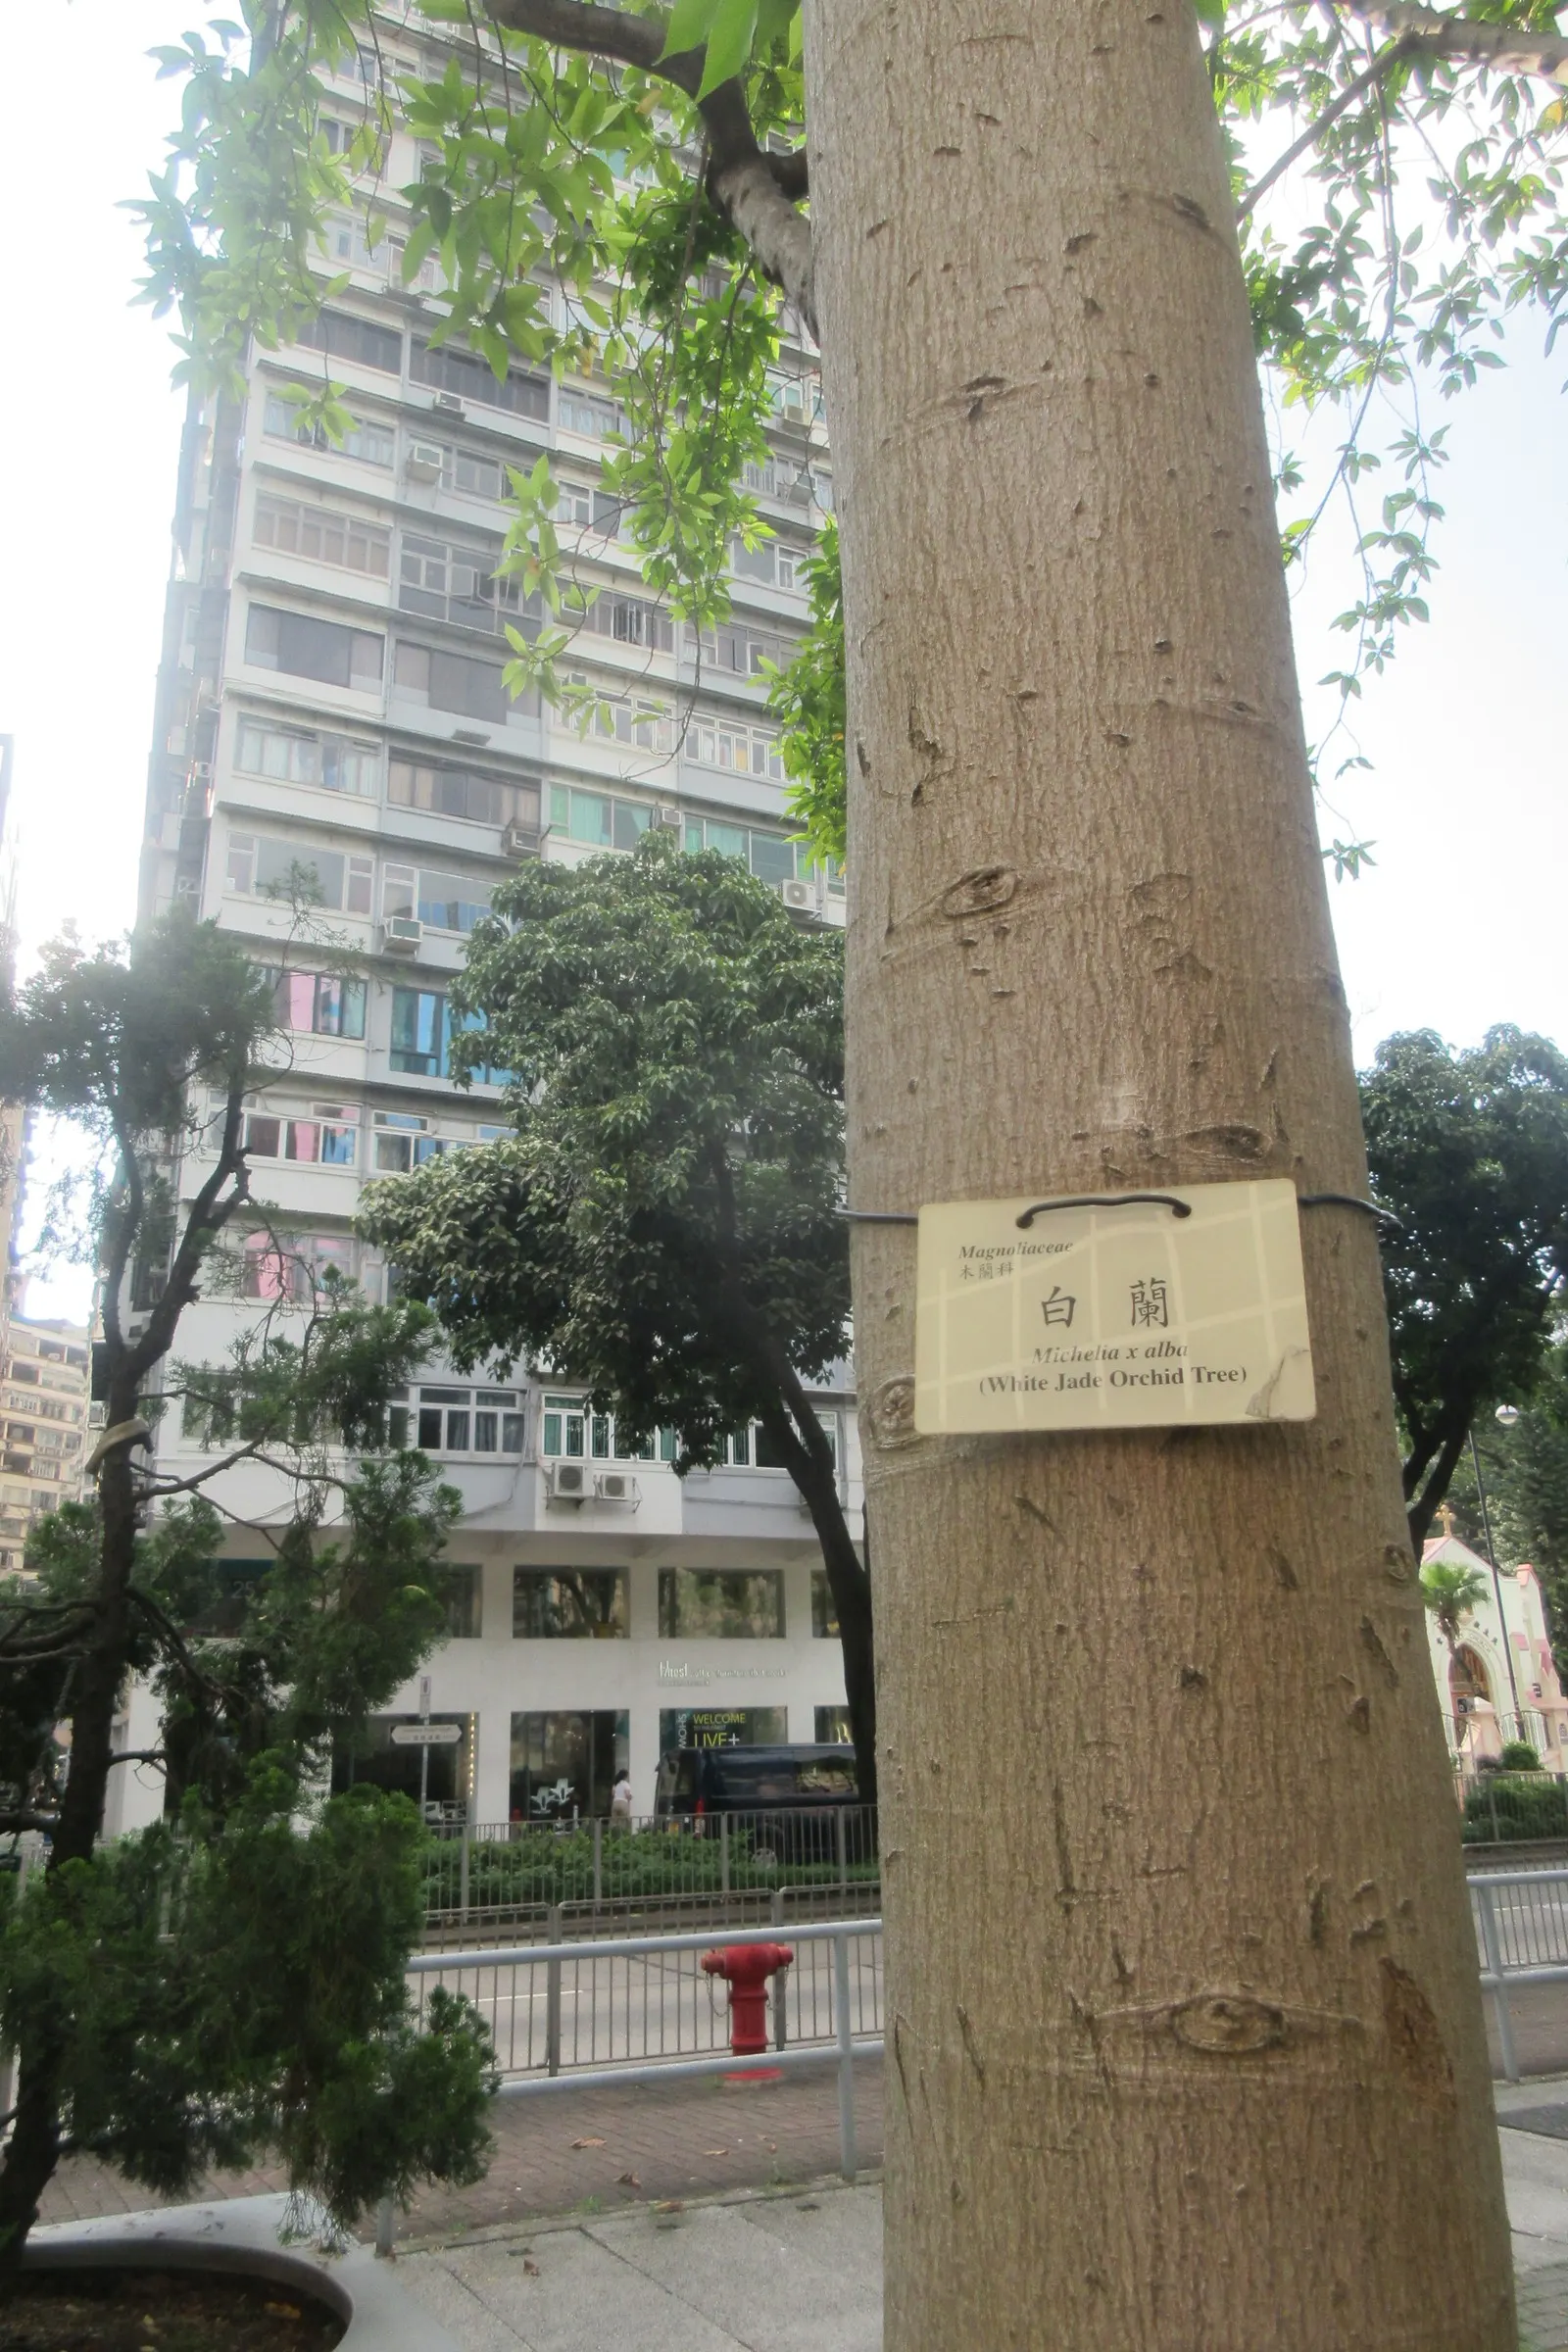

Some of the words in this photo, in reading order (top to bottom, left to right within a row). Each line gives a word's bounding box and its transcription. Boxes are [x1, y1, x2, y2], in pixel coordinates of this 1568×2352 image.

[958, 1242, 1074, 1260] Magnoliaceae
[959, 1261, 1014, 1280] 木蘭科
[1041, 1277, 1168, 1328] 白蘭
[1032, 1345, 1119, 1363] Michelia
[1125, 1347, 1138, 1359] x
[1145, 1341, 1188, 1359] alba
[979, 1375, 1049, 1396] (White
[1054, 1372, 1102, 1392] Jade
[1109, 1368, 1184, 1387] Orchid
[1191, 1365, 1248, 1384] Tree)
[693, 1713, 746, 1724] WELCOME
